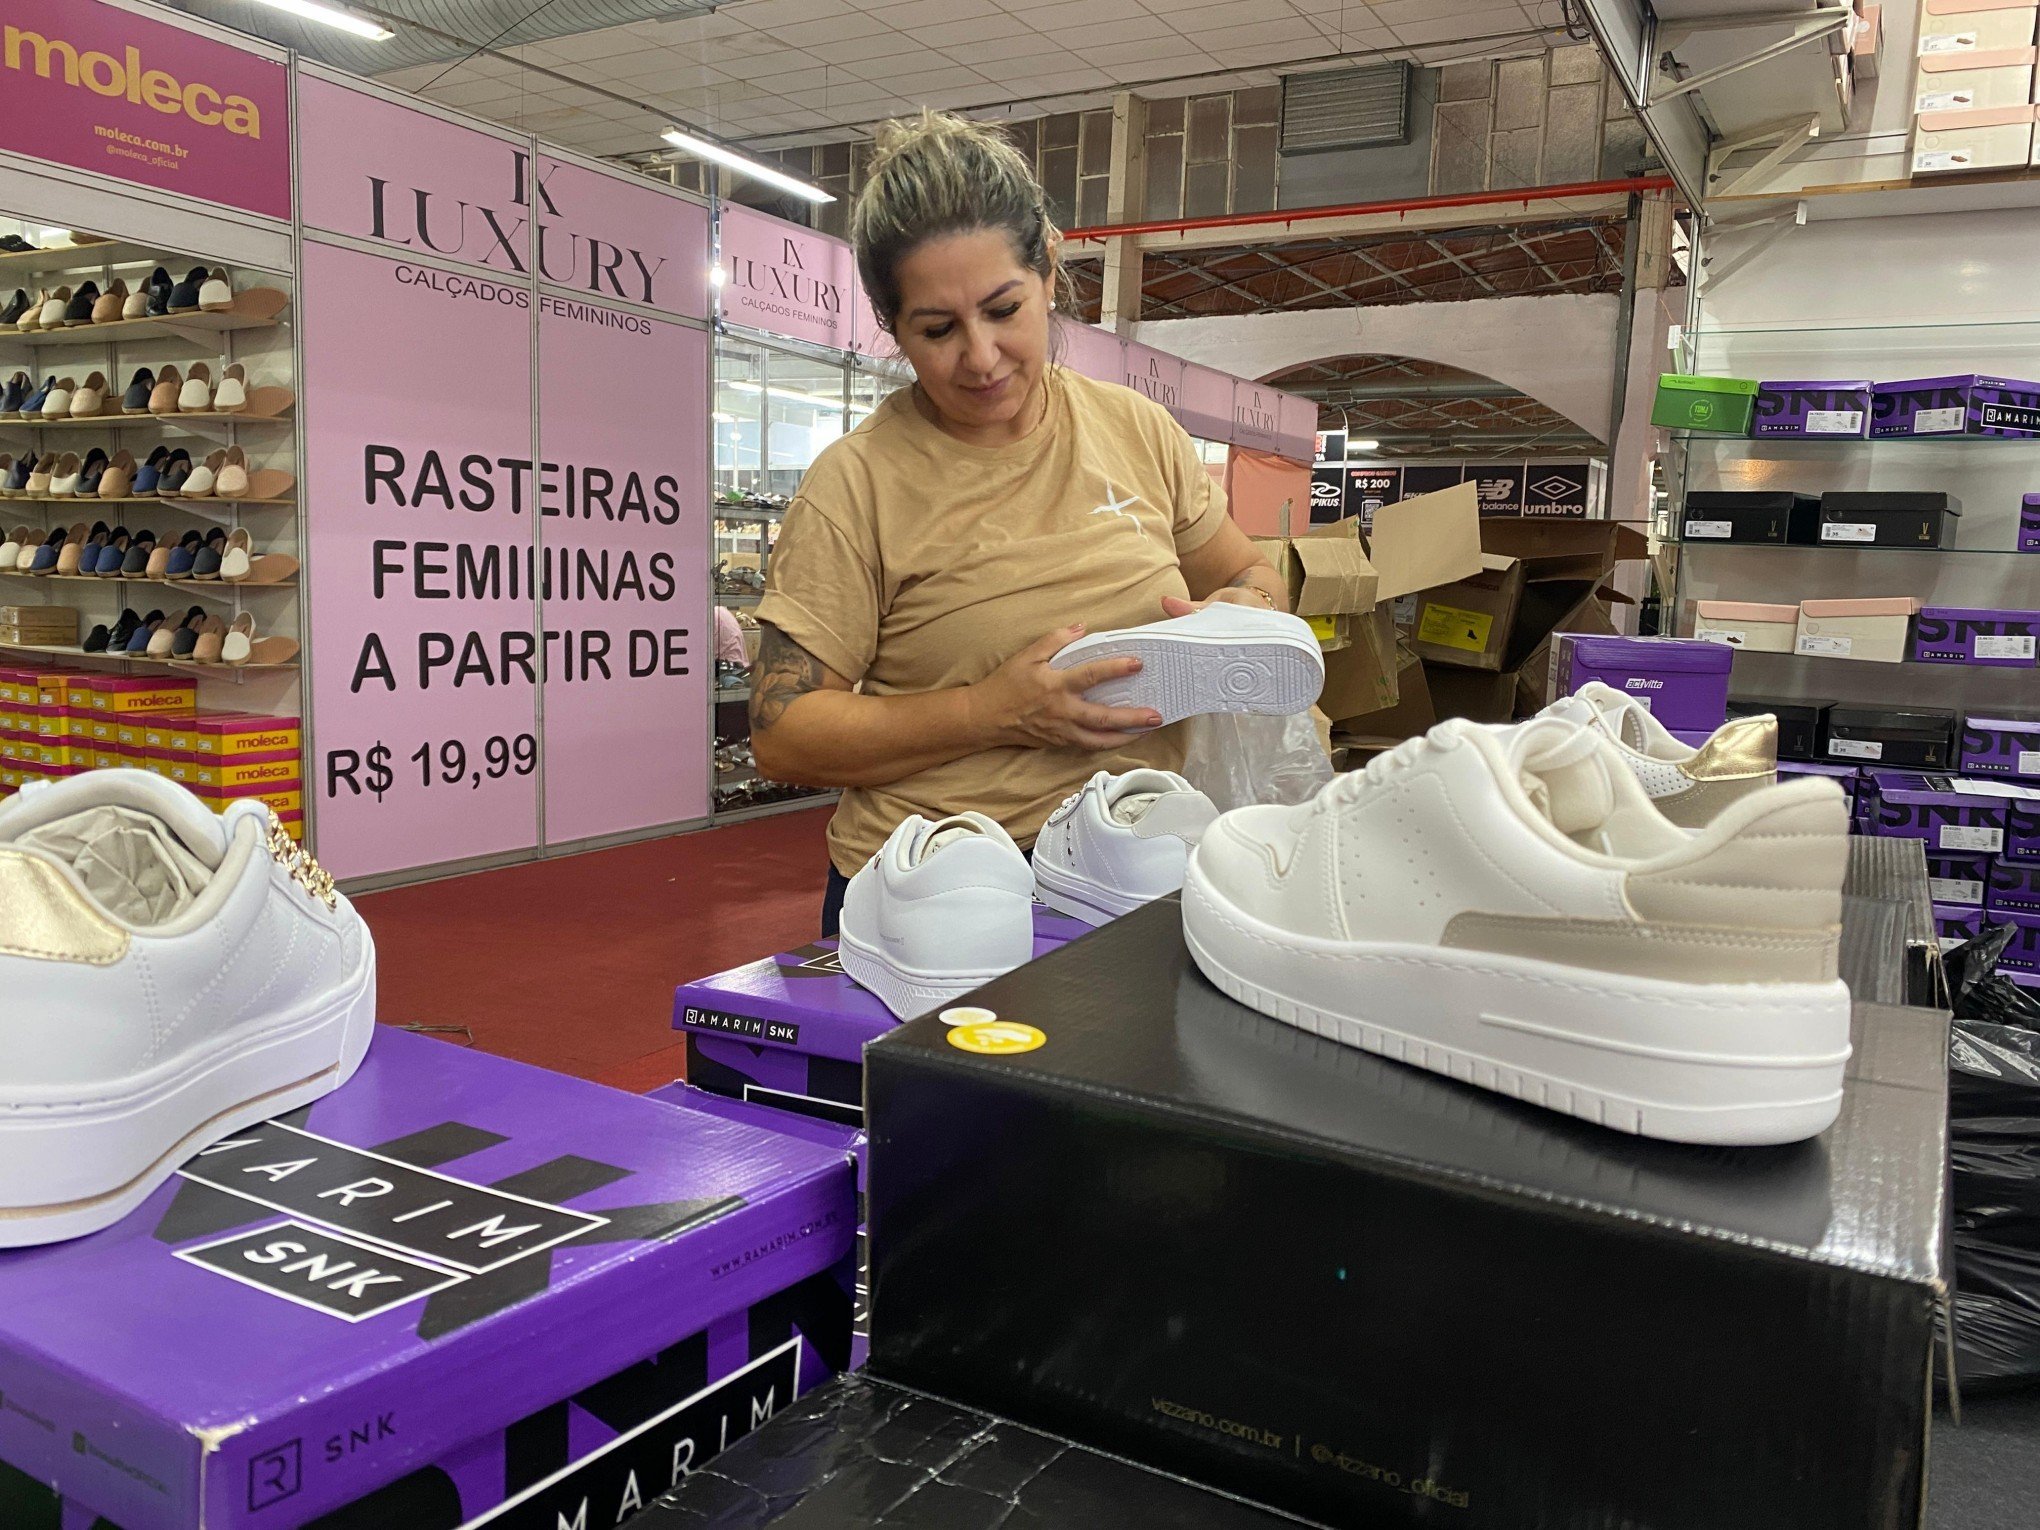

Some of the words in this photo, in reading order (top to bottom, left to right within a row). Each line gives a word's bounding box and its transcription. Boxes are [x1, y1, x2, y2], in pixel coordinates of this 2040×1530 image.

[4, 25, 261, 140] moleca
[94, 125, 189, 159] moleca.com.br
[106, 145, 180, 170] @moleca_oficial
[366, 175, 669, 305] LUXURY
[394, 265, 529, 310] CALÇADOS
[540, 297, 652, 336] FEMININOS
[730, 255, 847, 314] LUXURY
[741, 296, 791, 317] CALÇADOS
[793, 309, 838, 330] FEMININOS
[363, 444, 681, 526] RASTEIRAS
[1355, 478, 1368, 489] R$
[1370, 479, 1391, 489] 200
[1482, 501, 1519, 511] balance
[1524, 502, 1584, 515] umbro
[372, 539, 677, 602] FEMININAS
[350, 632, 397, 694] A
[418, 630, 612, 690] PARTIR
[628, 628, 690, 679] DE
[127, 694, 183, 707] moleca
[236, 733, 289, 749] moleca
[236, 764, 290, 780] moleca
[326, 739, 394, 804] R$
[410, 732, 537, 791] 19,99
[686, 1008, 761, 1034] RAMARIM
[768, 1025, 795, 1041] SNK
[243, 1240, 404, 1299] SNK
[323, 1411, 398, 1463] SNK
[1151, 1397, 1282, 1450] vizzano.com.br
